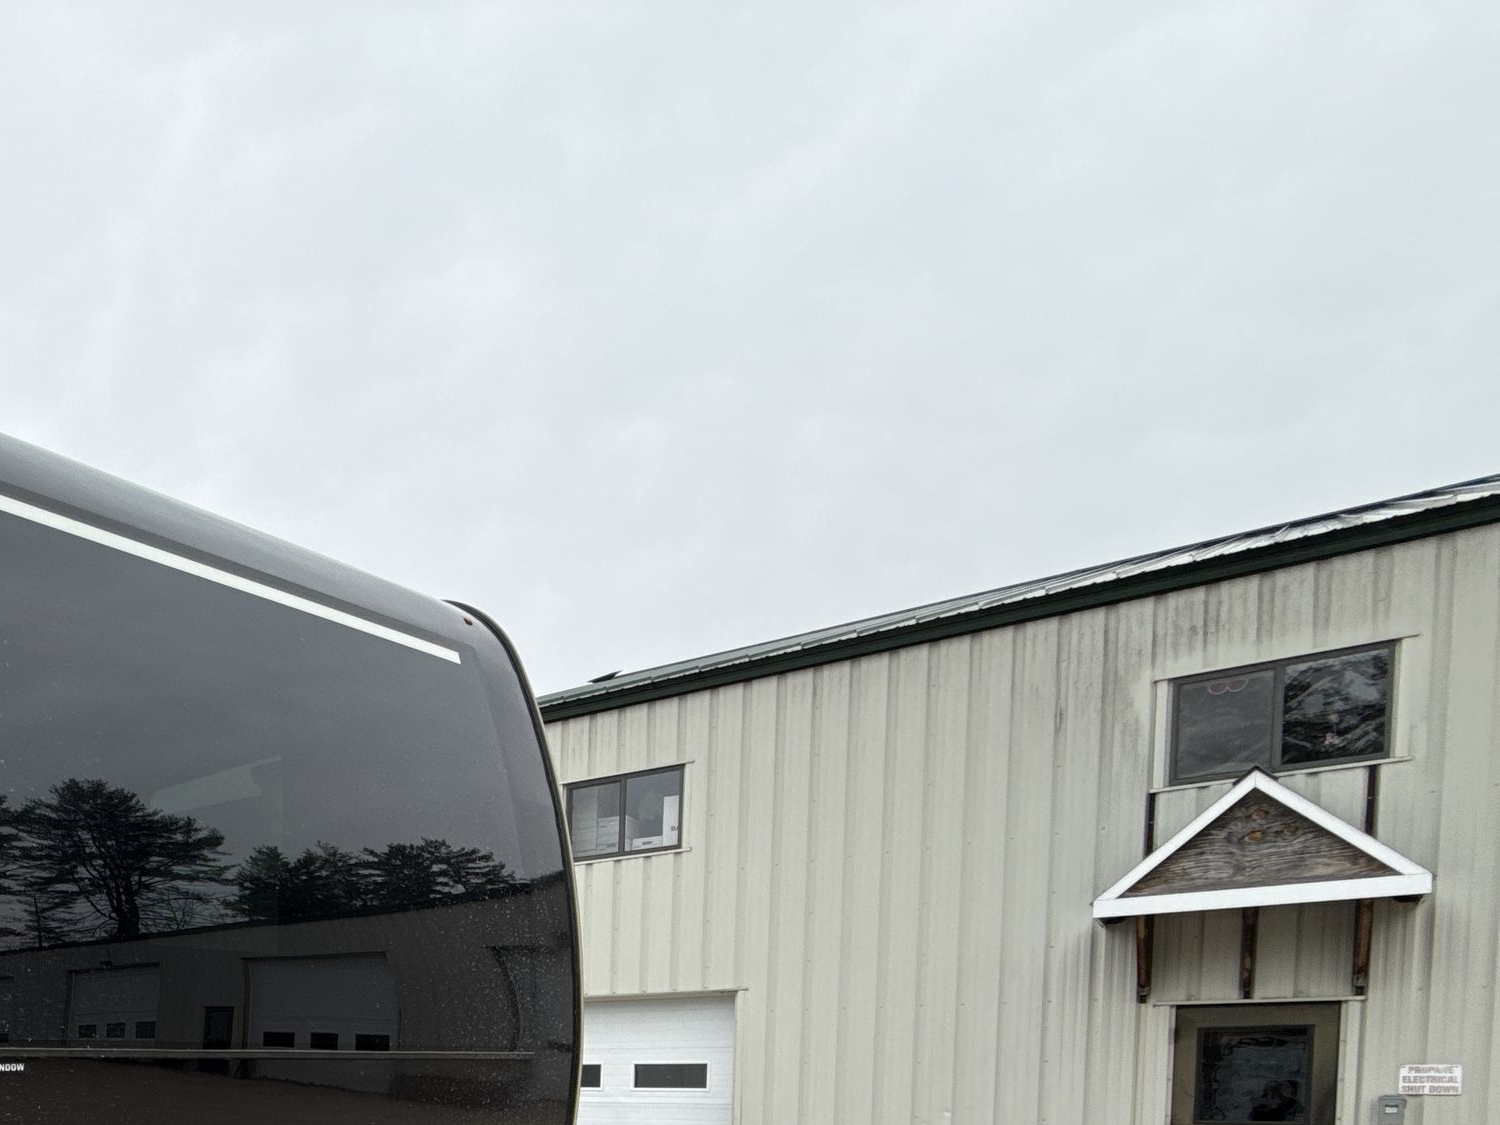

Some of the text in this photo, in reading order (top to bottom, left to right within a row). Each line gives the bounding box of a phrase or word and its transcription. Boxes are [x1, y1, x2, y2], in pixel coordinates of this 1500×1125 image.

[1402, 1075, 1460, 1084] ELECTRICAL
[1401, 1085, 1460, 1094] SHUT DOWN
